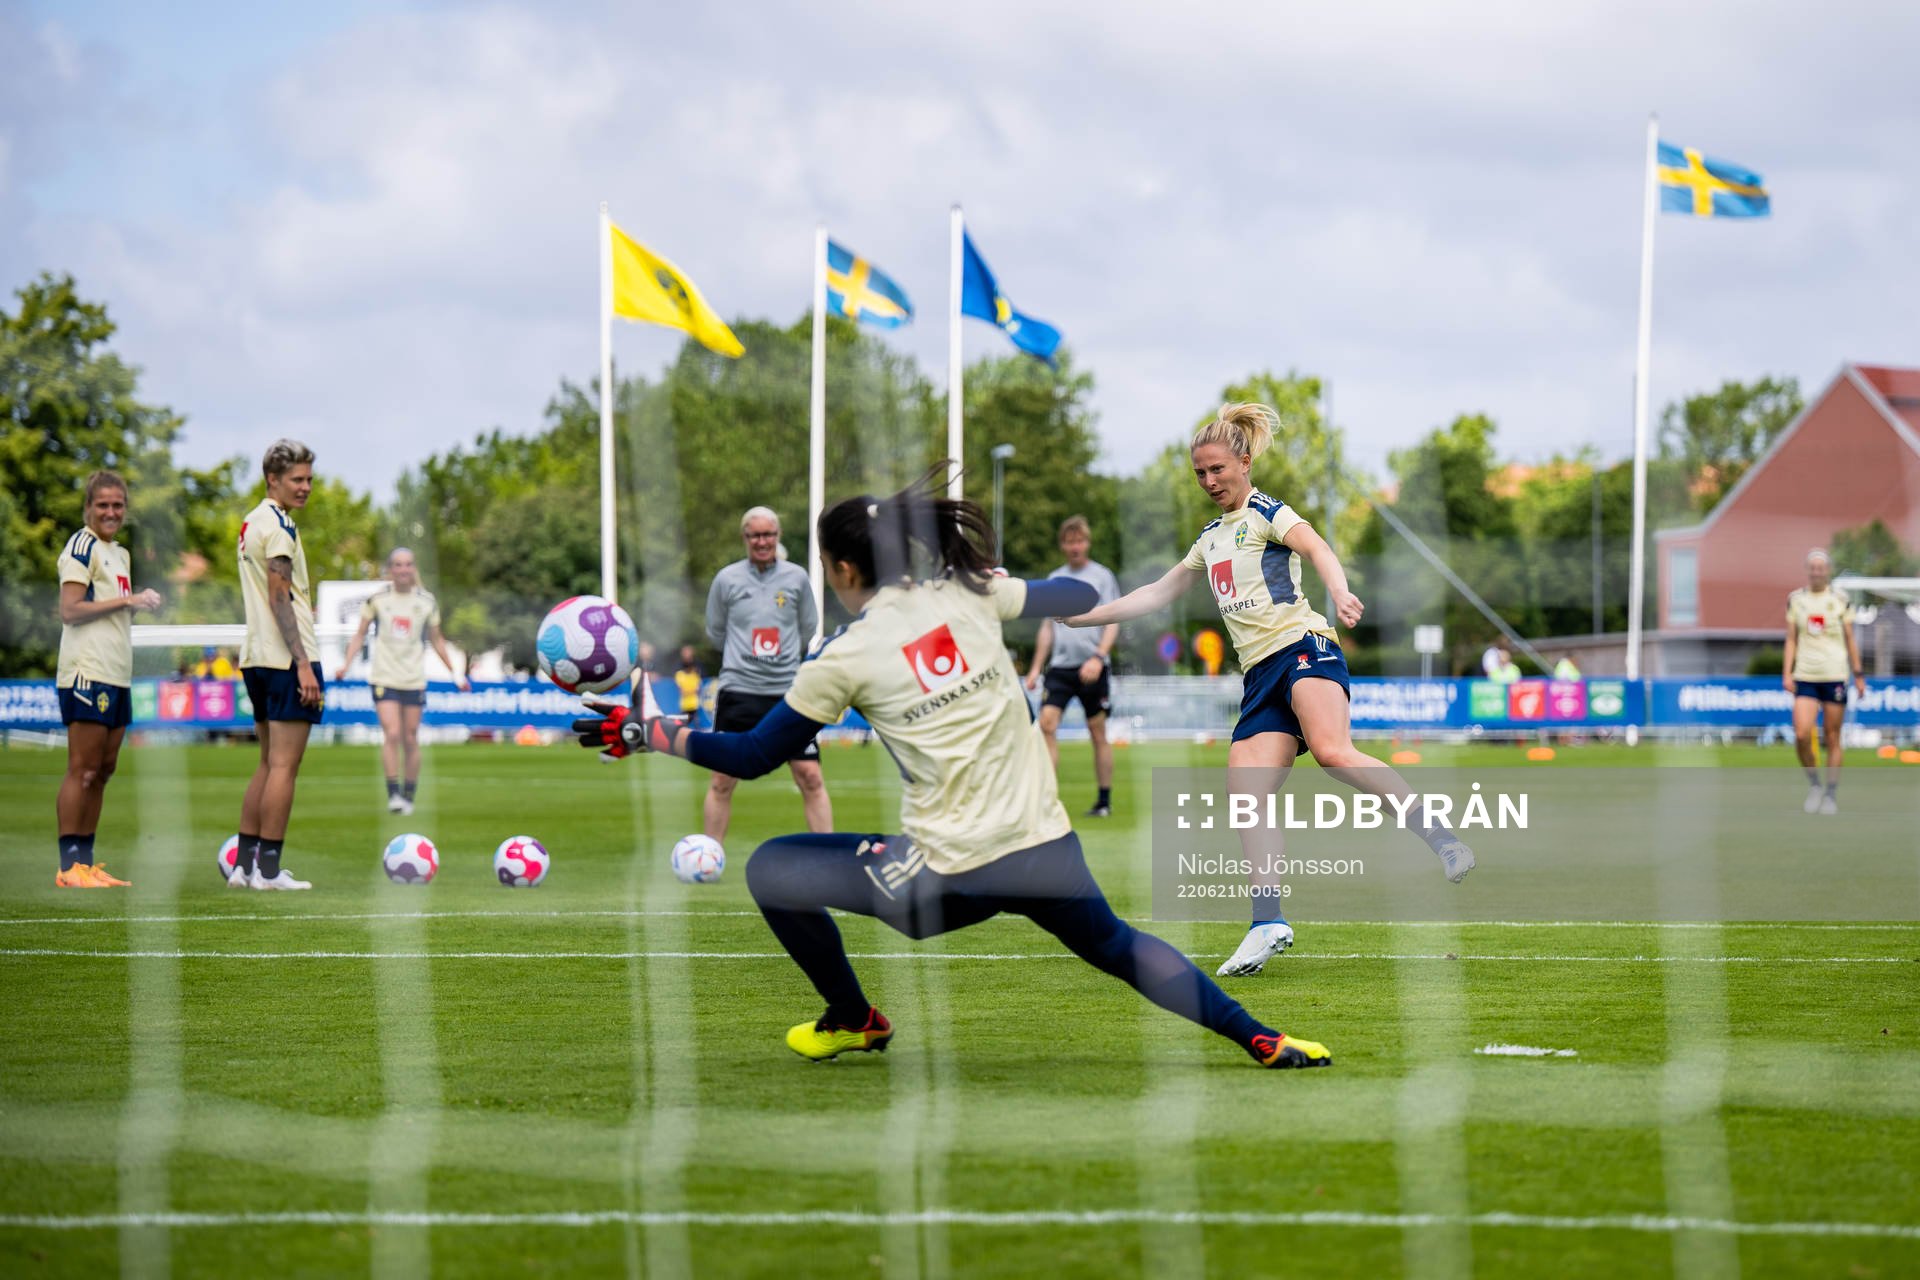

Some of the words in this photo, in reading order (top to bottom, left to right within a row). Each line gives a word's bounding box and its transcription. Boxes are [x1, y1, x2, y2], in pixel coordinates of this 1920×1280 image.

[1234, 598, 1257, 612] SPEL
[903, 685, 969, 724] SVENSKA
[971, 666, 1000, 689] SPEL
